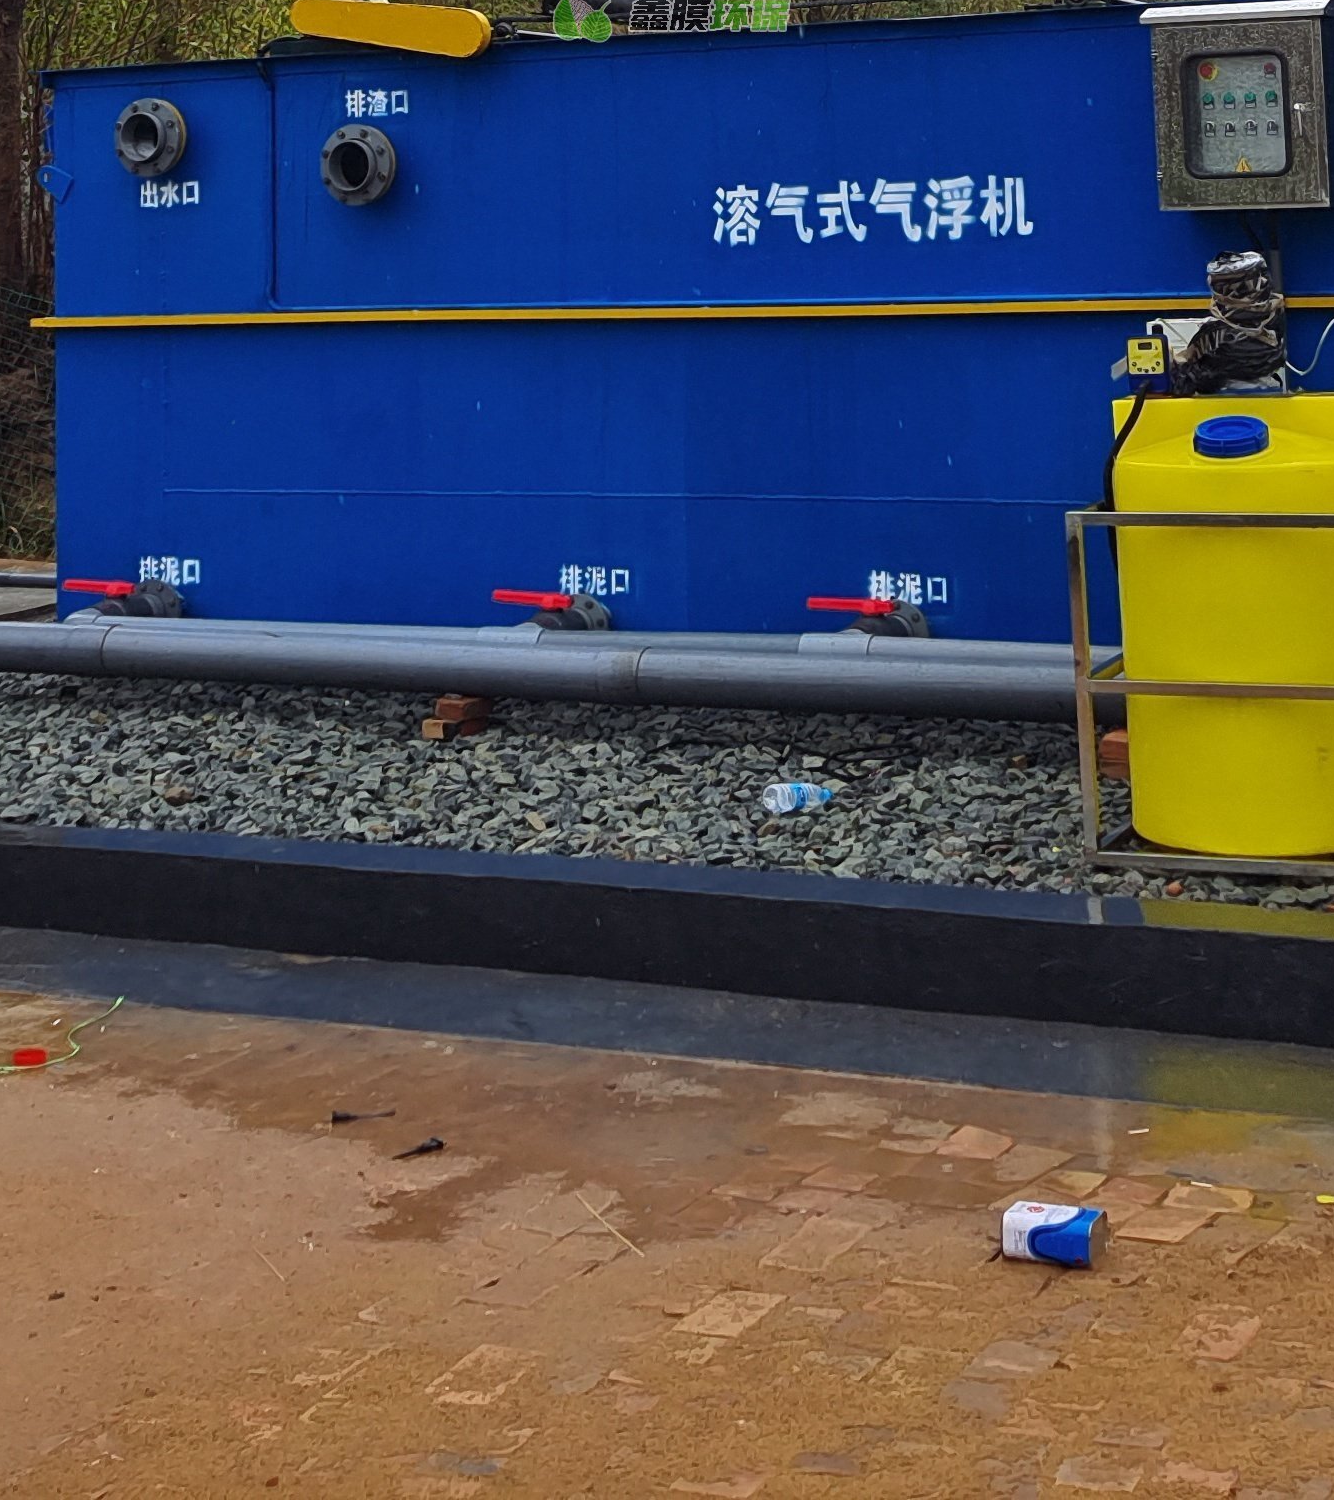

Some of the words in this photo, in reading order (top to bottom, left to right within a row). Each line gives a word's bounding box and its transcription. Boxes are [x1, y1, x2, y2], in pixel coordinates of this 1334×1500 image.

[345, 89, 410, 117] 排渣口
[140, 180, 200, 208] 出水口
[713, 175, 1034, 247] 溶气式气浮机
[139, 556, 200, 586] 排泥口
[559, 563, 629, 596] 排泥口
[868, 570, 947, 605] 排泥口
